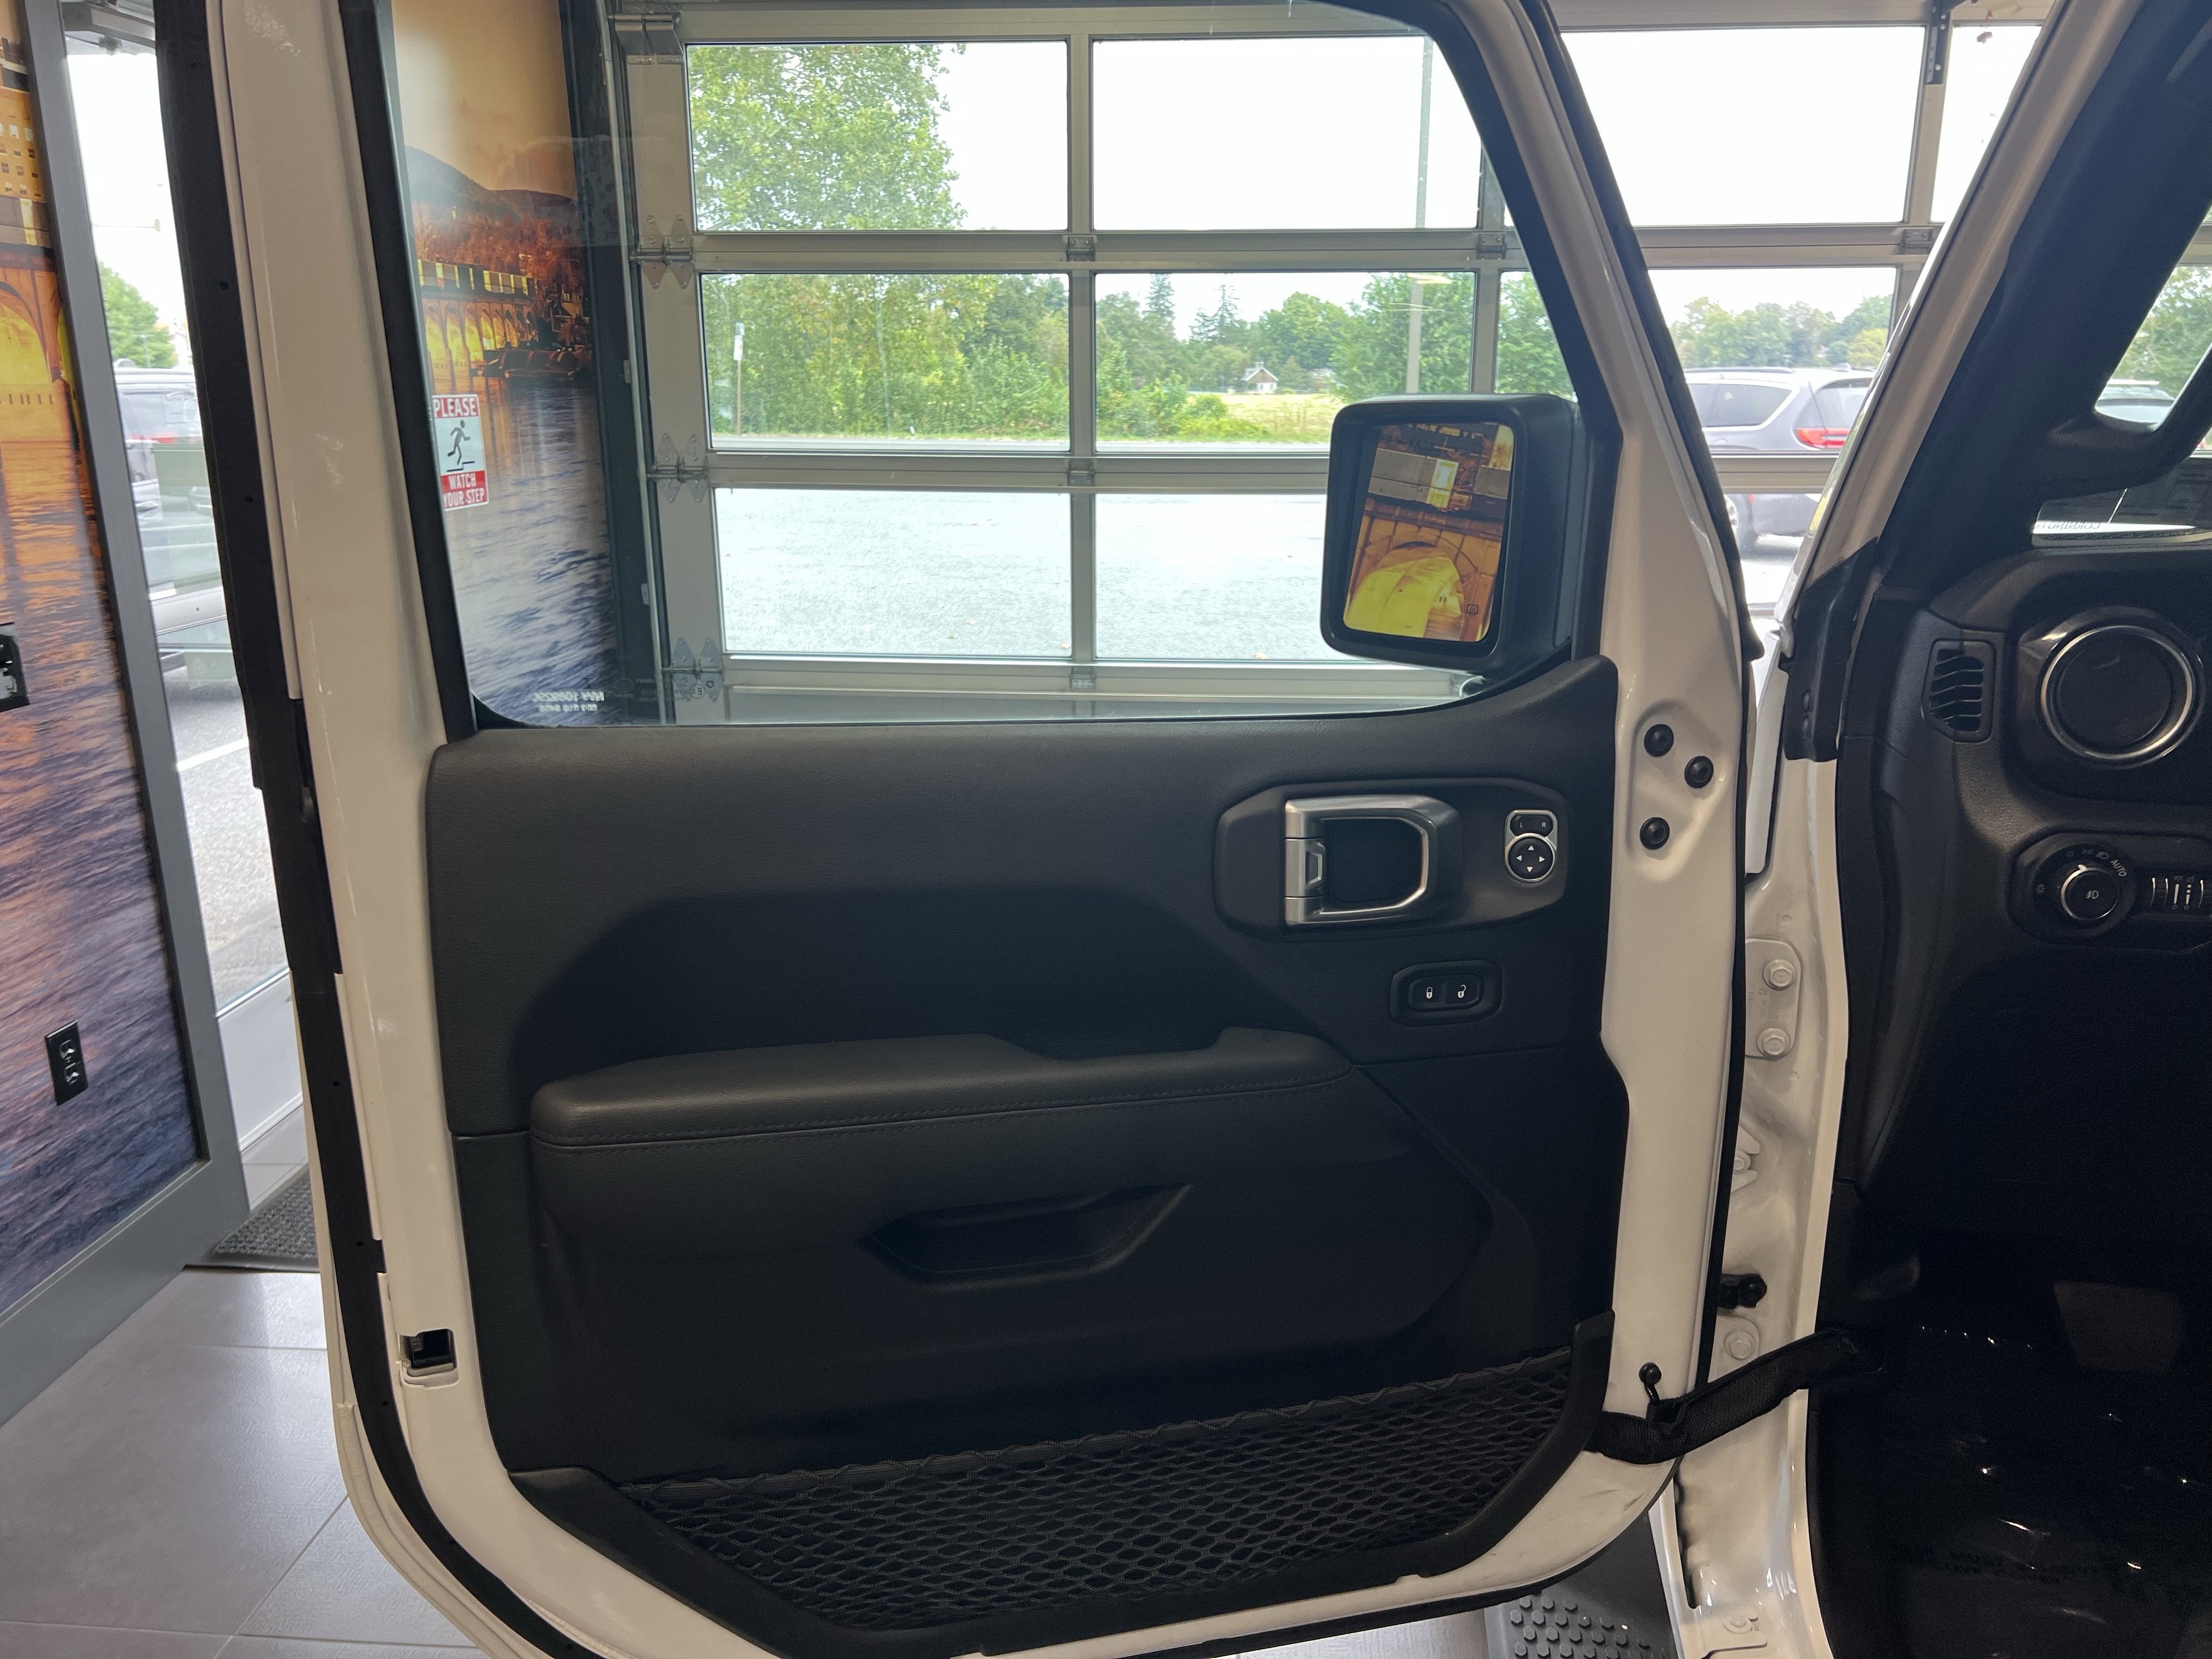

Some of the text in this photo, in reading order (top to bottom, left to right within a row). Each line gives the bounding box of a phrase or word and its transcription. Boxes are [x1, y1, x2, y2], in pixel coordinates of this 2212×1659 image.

[433, 398, 477, 417] PLEASE
[448, 472, 477, 490] WATCH
[444, 487, 486, 507] YOUR STEP
[2111, 860, 2127, 877] AUTO
